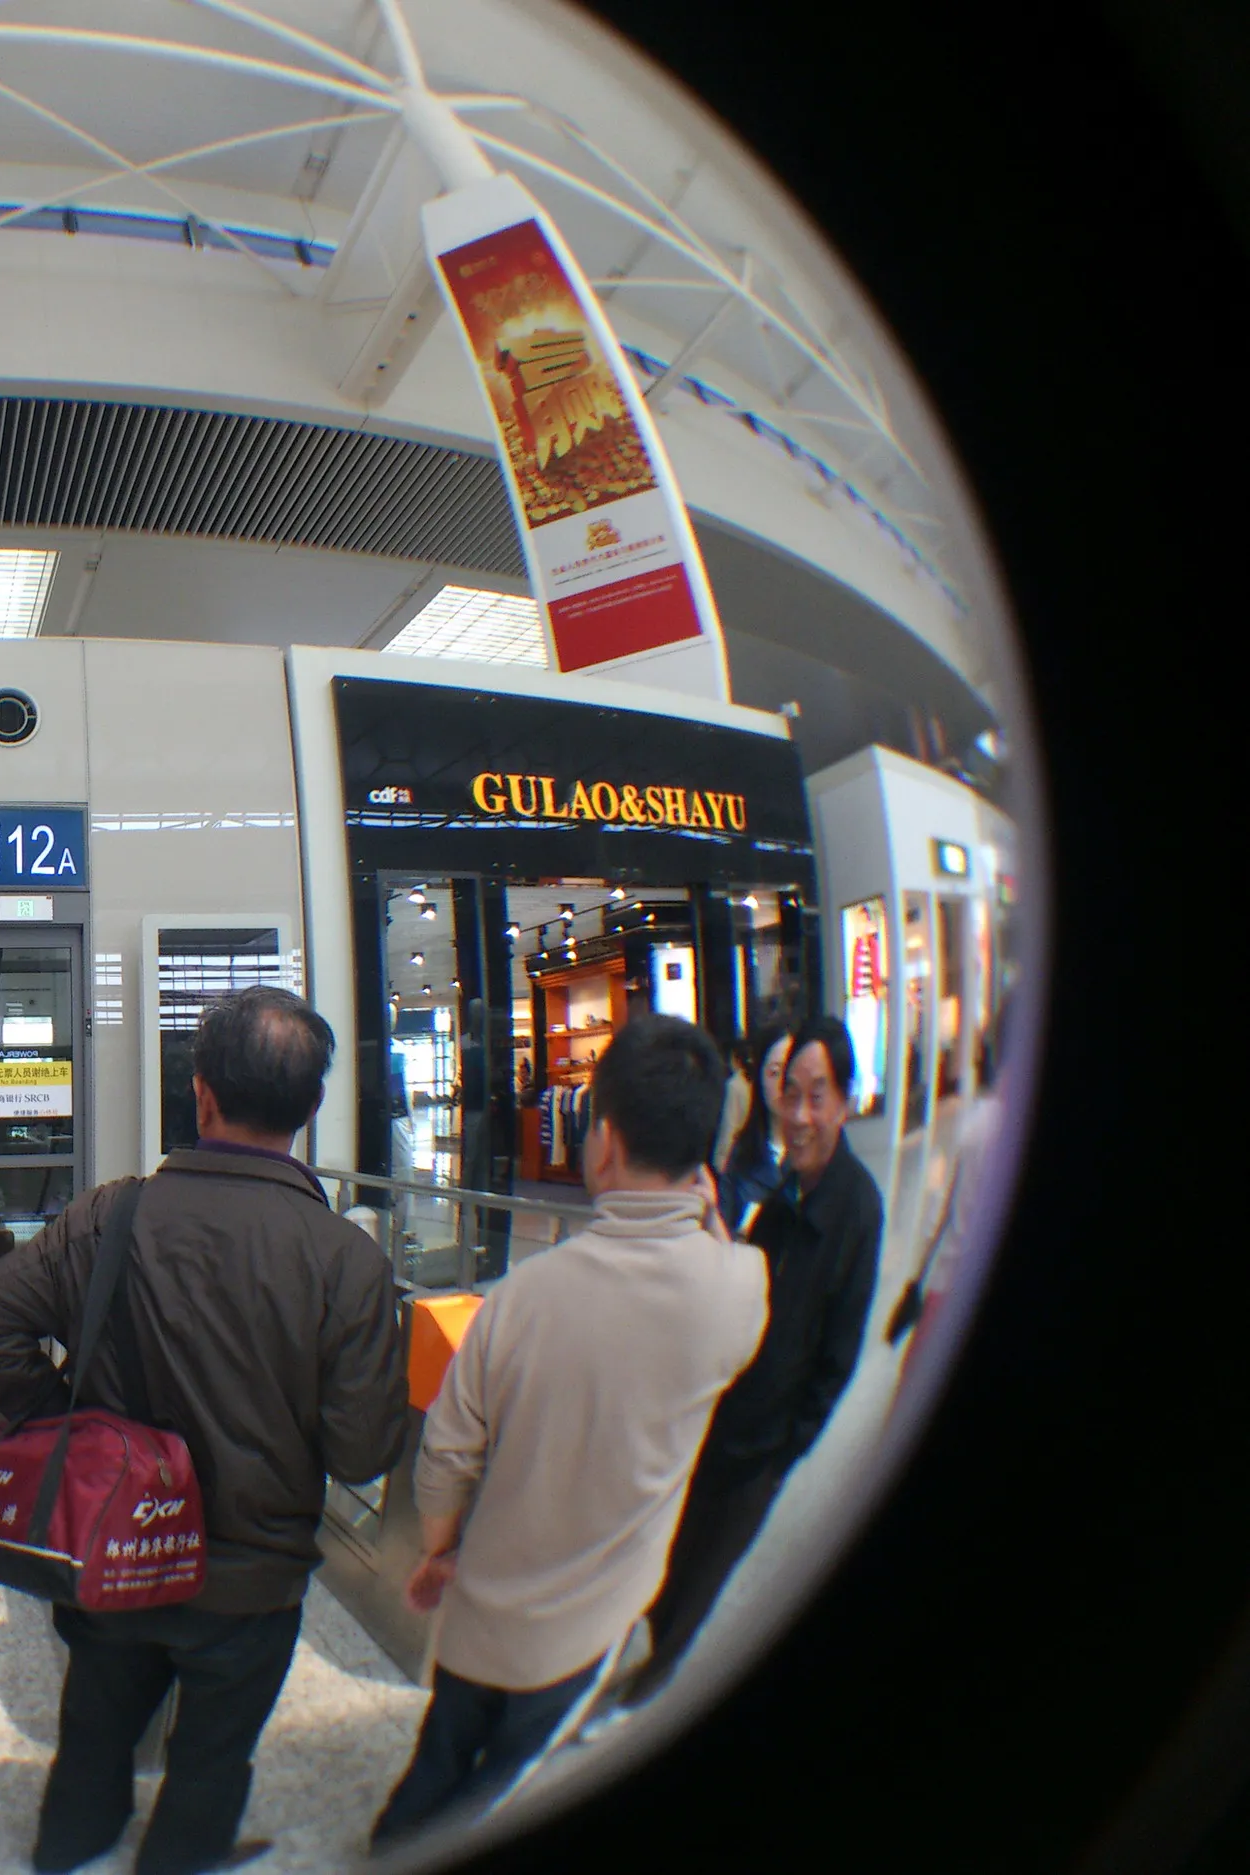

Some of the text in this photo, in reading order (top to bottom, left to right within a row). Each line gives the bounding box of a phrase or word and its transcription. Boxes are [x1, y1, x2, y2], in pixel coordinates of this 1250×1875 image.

[369, 785, 397, 804] cdf
[471, 772, 747, 832] GULAO&SHAYU
[8, 824, 77, 875] 12A
[24, 1093, 50, 1103] SRCB
